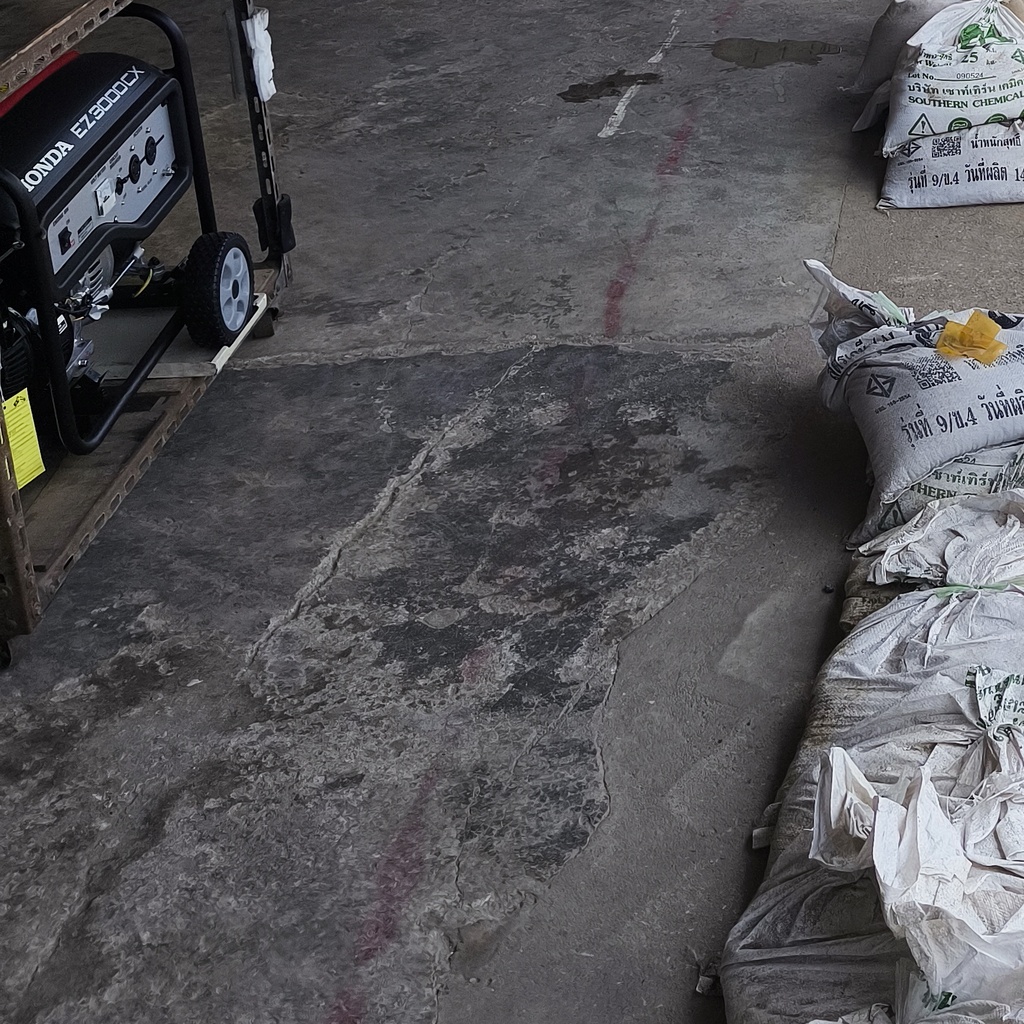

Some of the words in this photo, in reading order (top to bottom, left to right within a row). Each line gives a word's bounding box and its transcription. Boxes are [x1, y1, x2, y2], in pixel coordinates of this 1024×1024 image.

[960, 51, 979, 63] 25
[907, 72, 918, 81] Lot
[919, 73, 936, 81] No.
[956, 72, 984, 80] 090524
[907, 82, 940, 96] บริษัท
[942, 80, 997, 97] เซาท์เทิร์น
[69, 64, 146, 140] EZ3000CX
[908, 95, 968, 109] SOUTHERN
[970, 134, 1022, 150] น้ำหนักสุทธิ
[908, 166, 928, 194] รุ่นที่
[964, 158, 1008, 184] วันที่ผลิต
[901, 404, 934, 448] รุ่นที่
